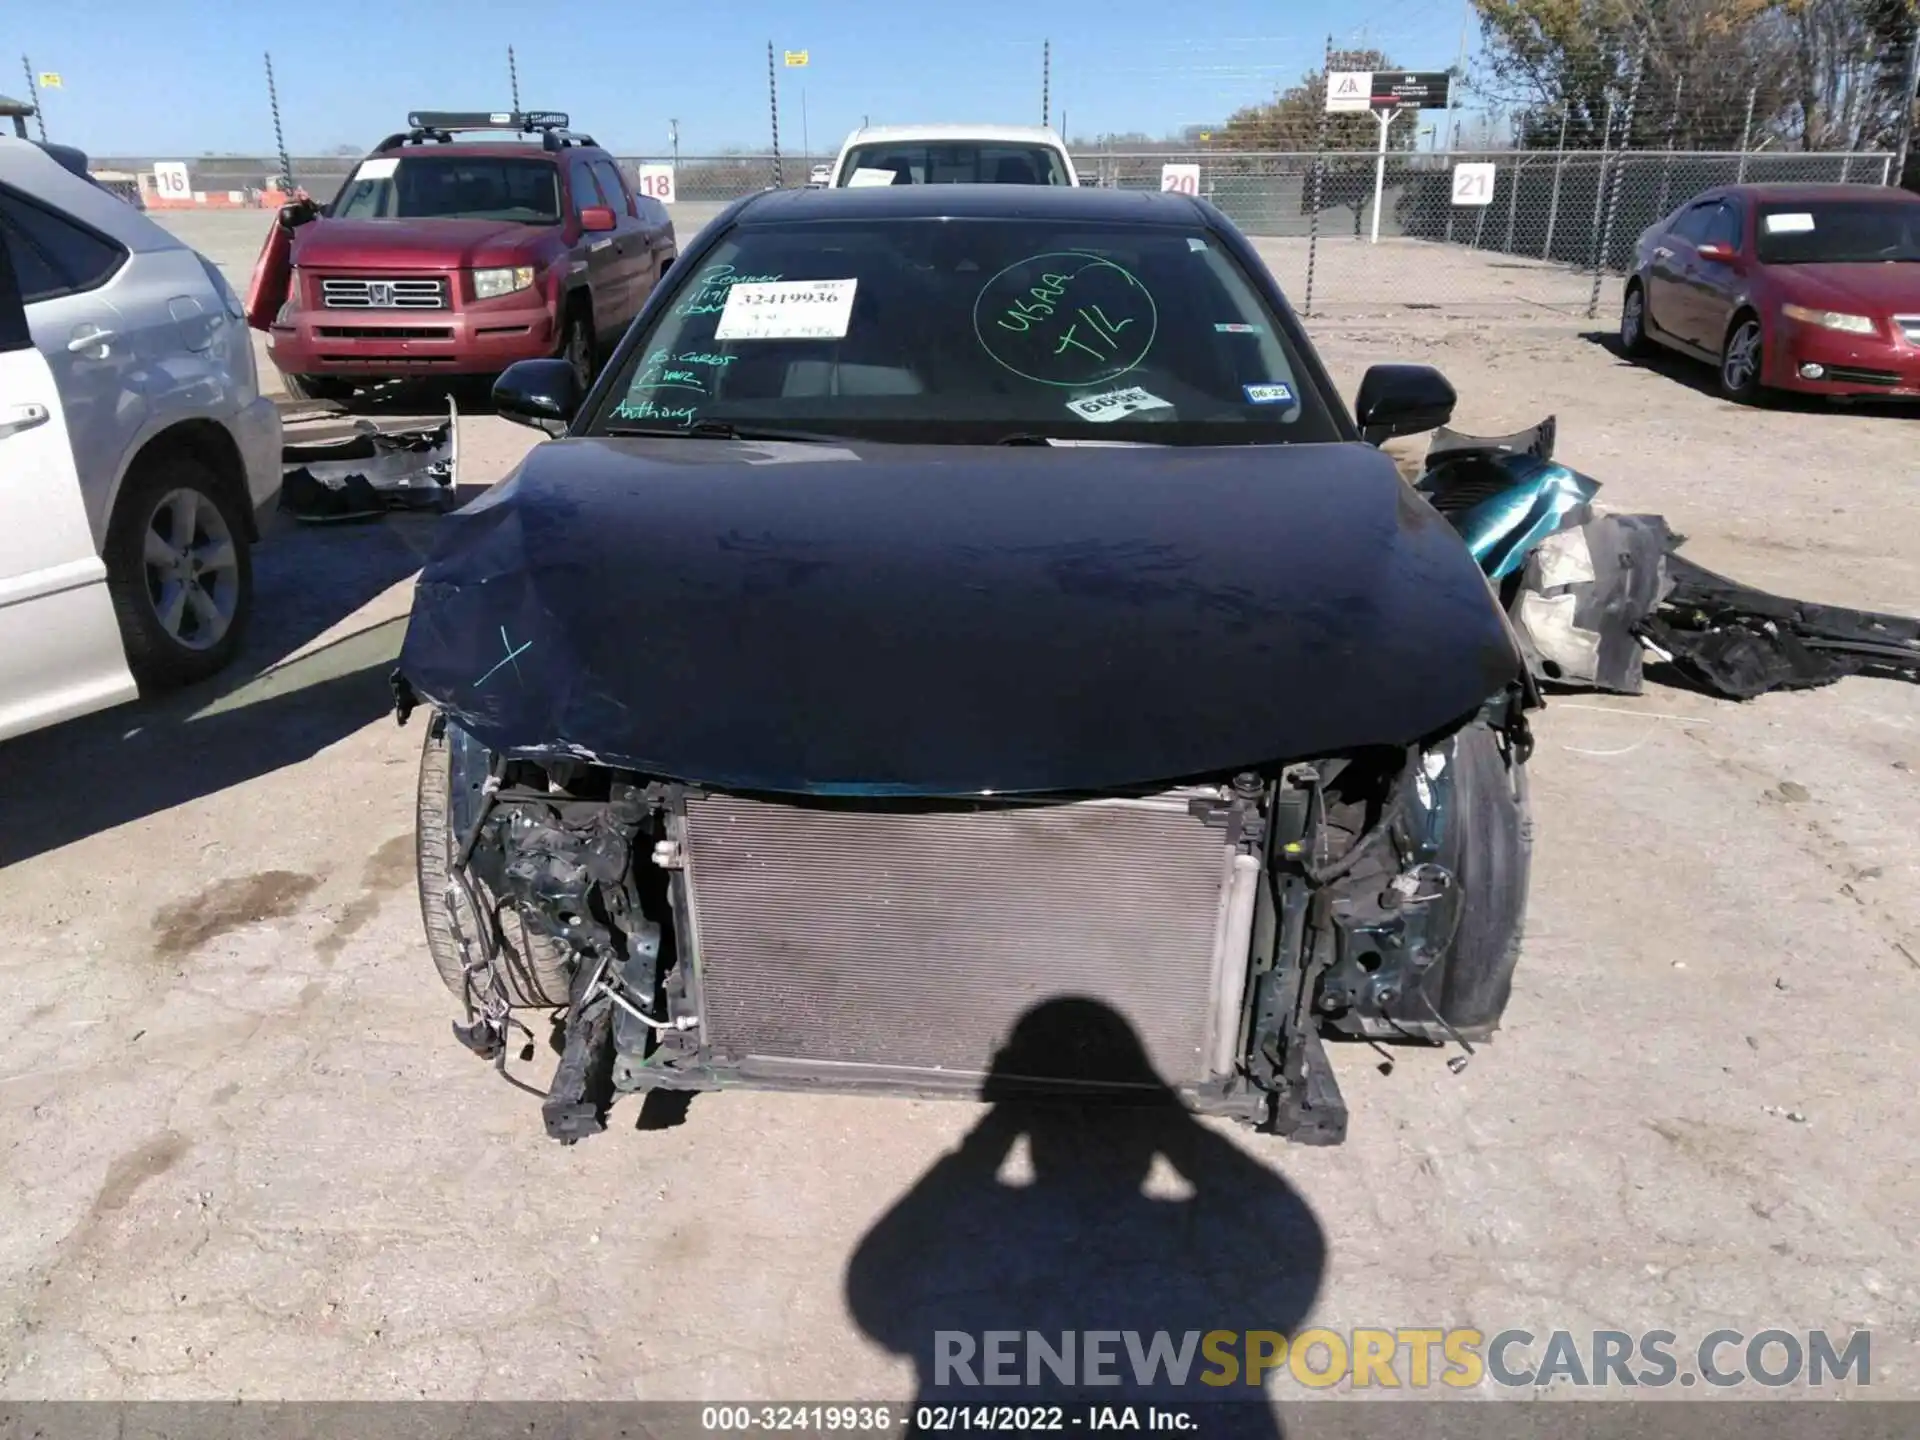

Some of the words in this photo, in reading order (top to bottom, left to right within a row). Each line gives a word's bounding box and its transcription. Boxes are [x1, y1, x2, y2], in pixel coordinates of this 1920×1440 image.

[160, 171, 184, 192] 16
[643, 175, 670, 197] 18
[1164, 174, 1195, 195] 20
[1457, 174, 1487, 197] 21
[738, 291, 839, 305] 32419936
[997, 273, 1075, 331] USAA
